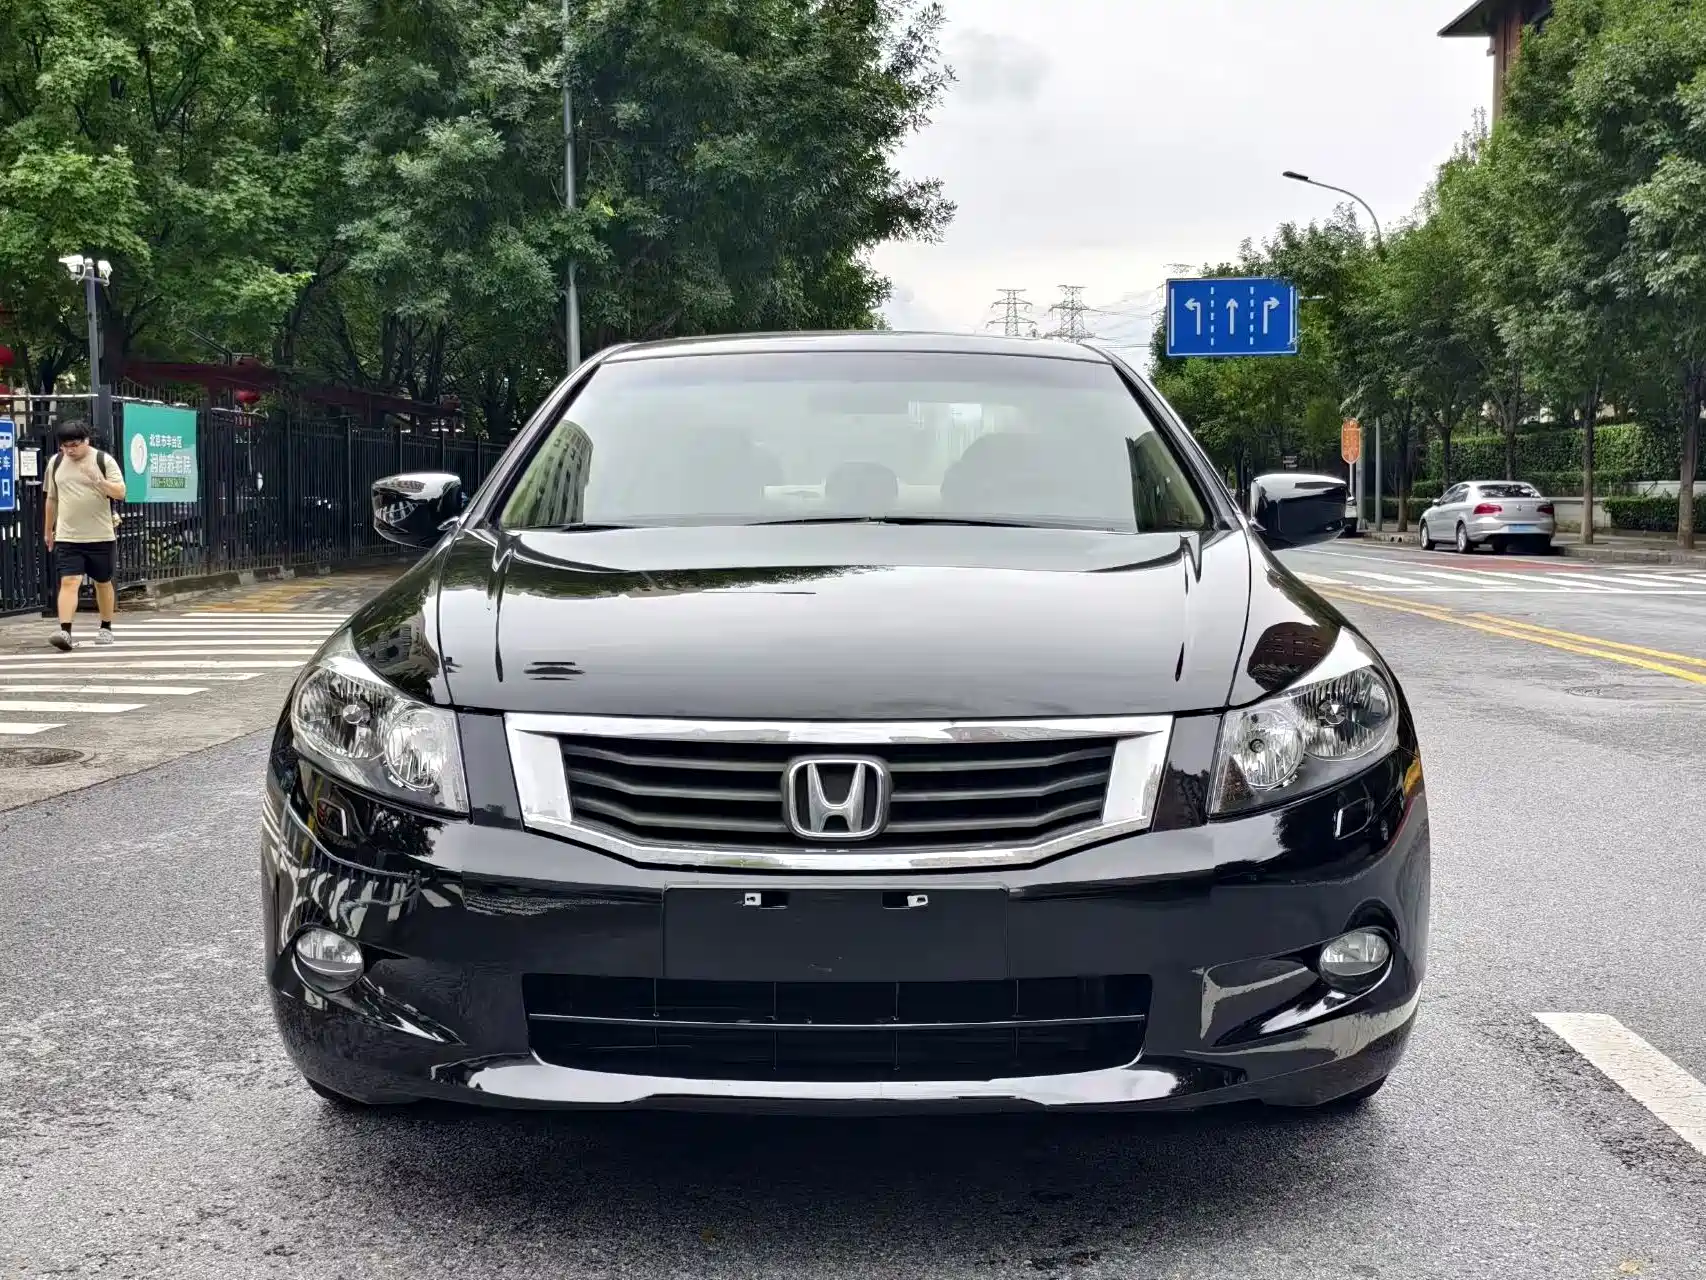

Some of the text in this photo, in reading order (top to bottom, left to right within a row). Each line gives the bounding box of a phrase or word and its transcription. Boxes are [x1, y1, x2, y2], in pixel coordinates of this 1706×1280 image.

[149, 433, 182, 449] 北京市丰台区
[0, 455, 11, 471] 车
